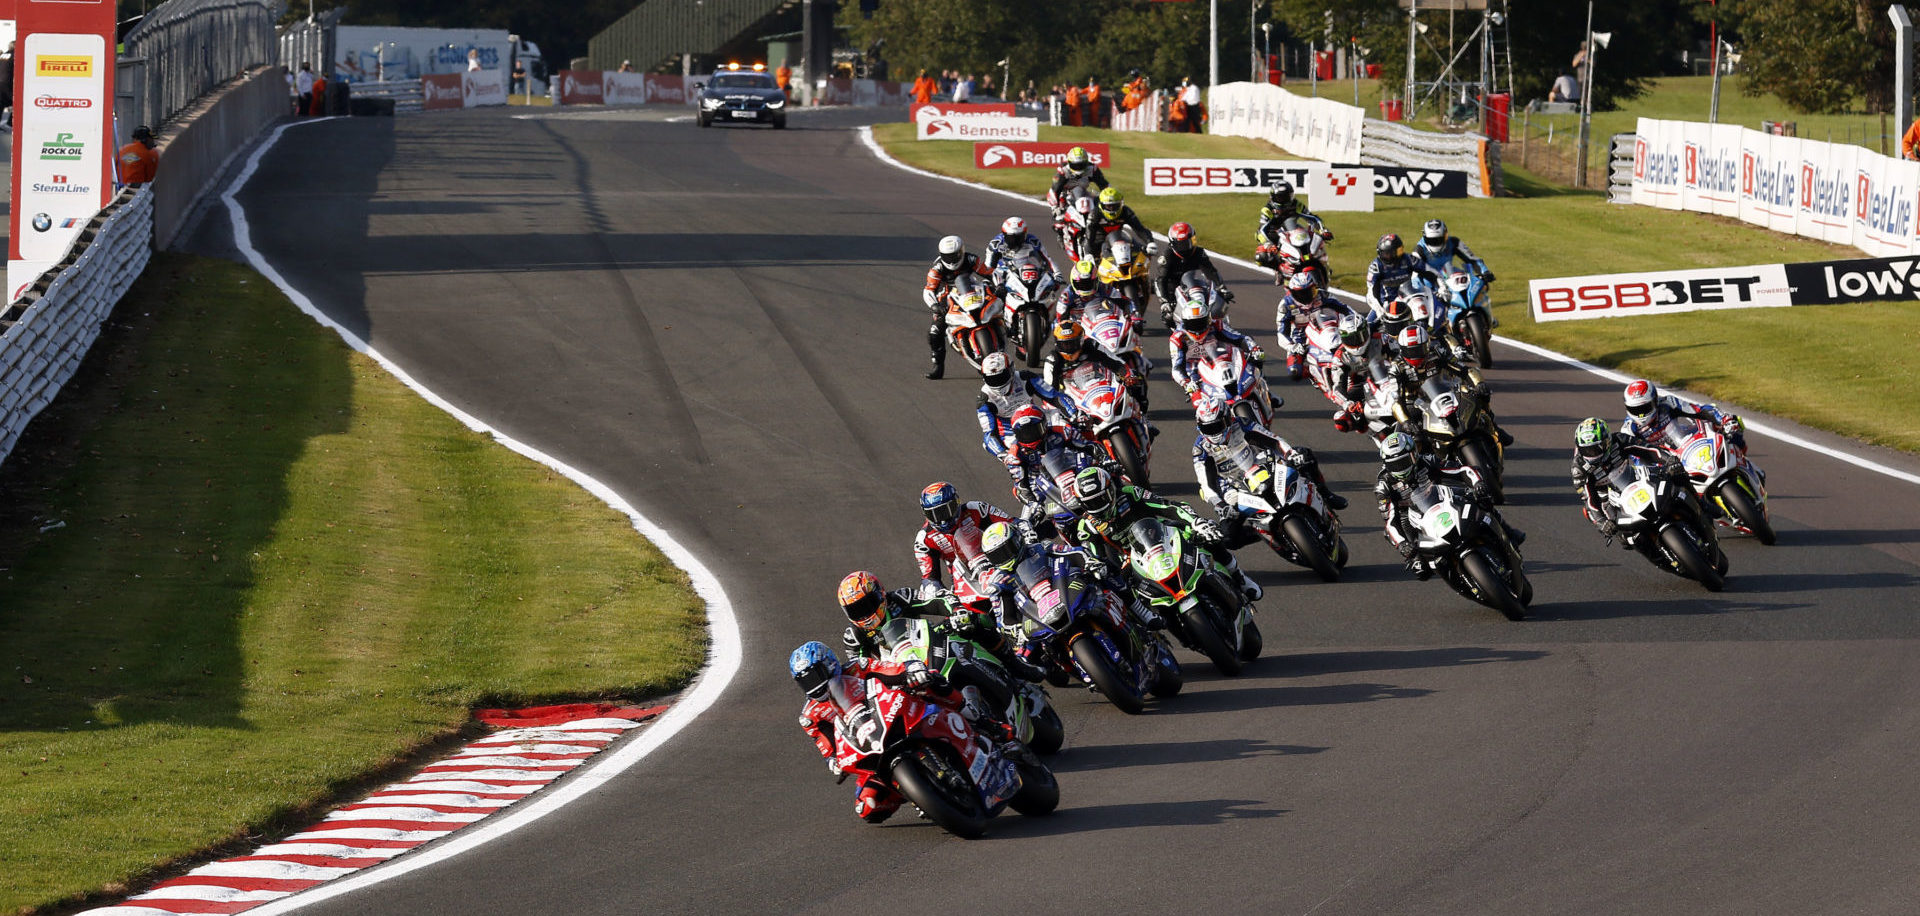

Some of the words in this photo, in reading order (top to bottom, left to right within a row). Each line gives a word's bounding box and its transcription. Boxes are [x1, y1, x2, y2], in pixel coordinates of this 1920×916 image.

[41, 61, 88, 71] PIRELLI
[37, 98, 88, 107] QUATTRO
[959, 124, 1030, 138] Bennetts
[1022, 151, 1102, 164] Bennts
[32, 183, 65, 192] Stena
[66, 184, 89, 193] Line
[1373, 174, 1415, 196] ow
[1023, 271, 1038, 280] 99
[1455, 276, 1467, 285] 10
[1099, 328, 1119, 340] 33
[1222, 368, 1233, 382] 41
[1436, 511, 1453, 528] 2
[1037, 589, 1061, 618] 22
